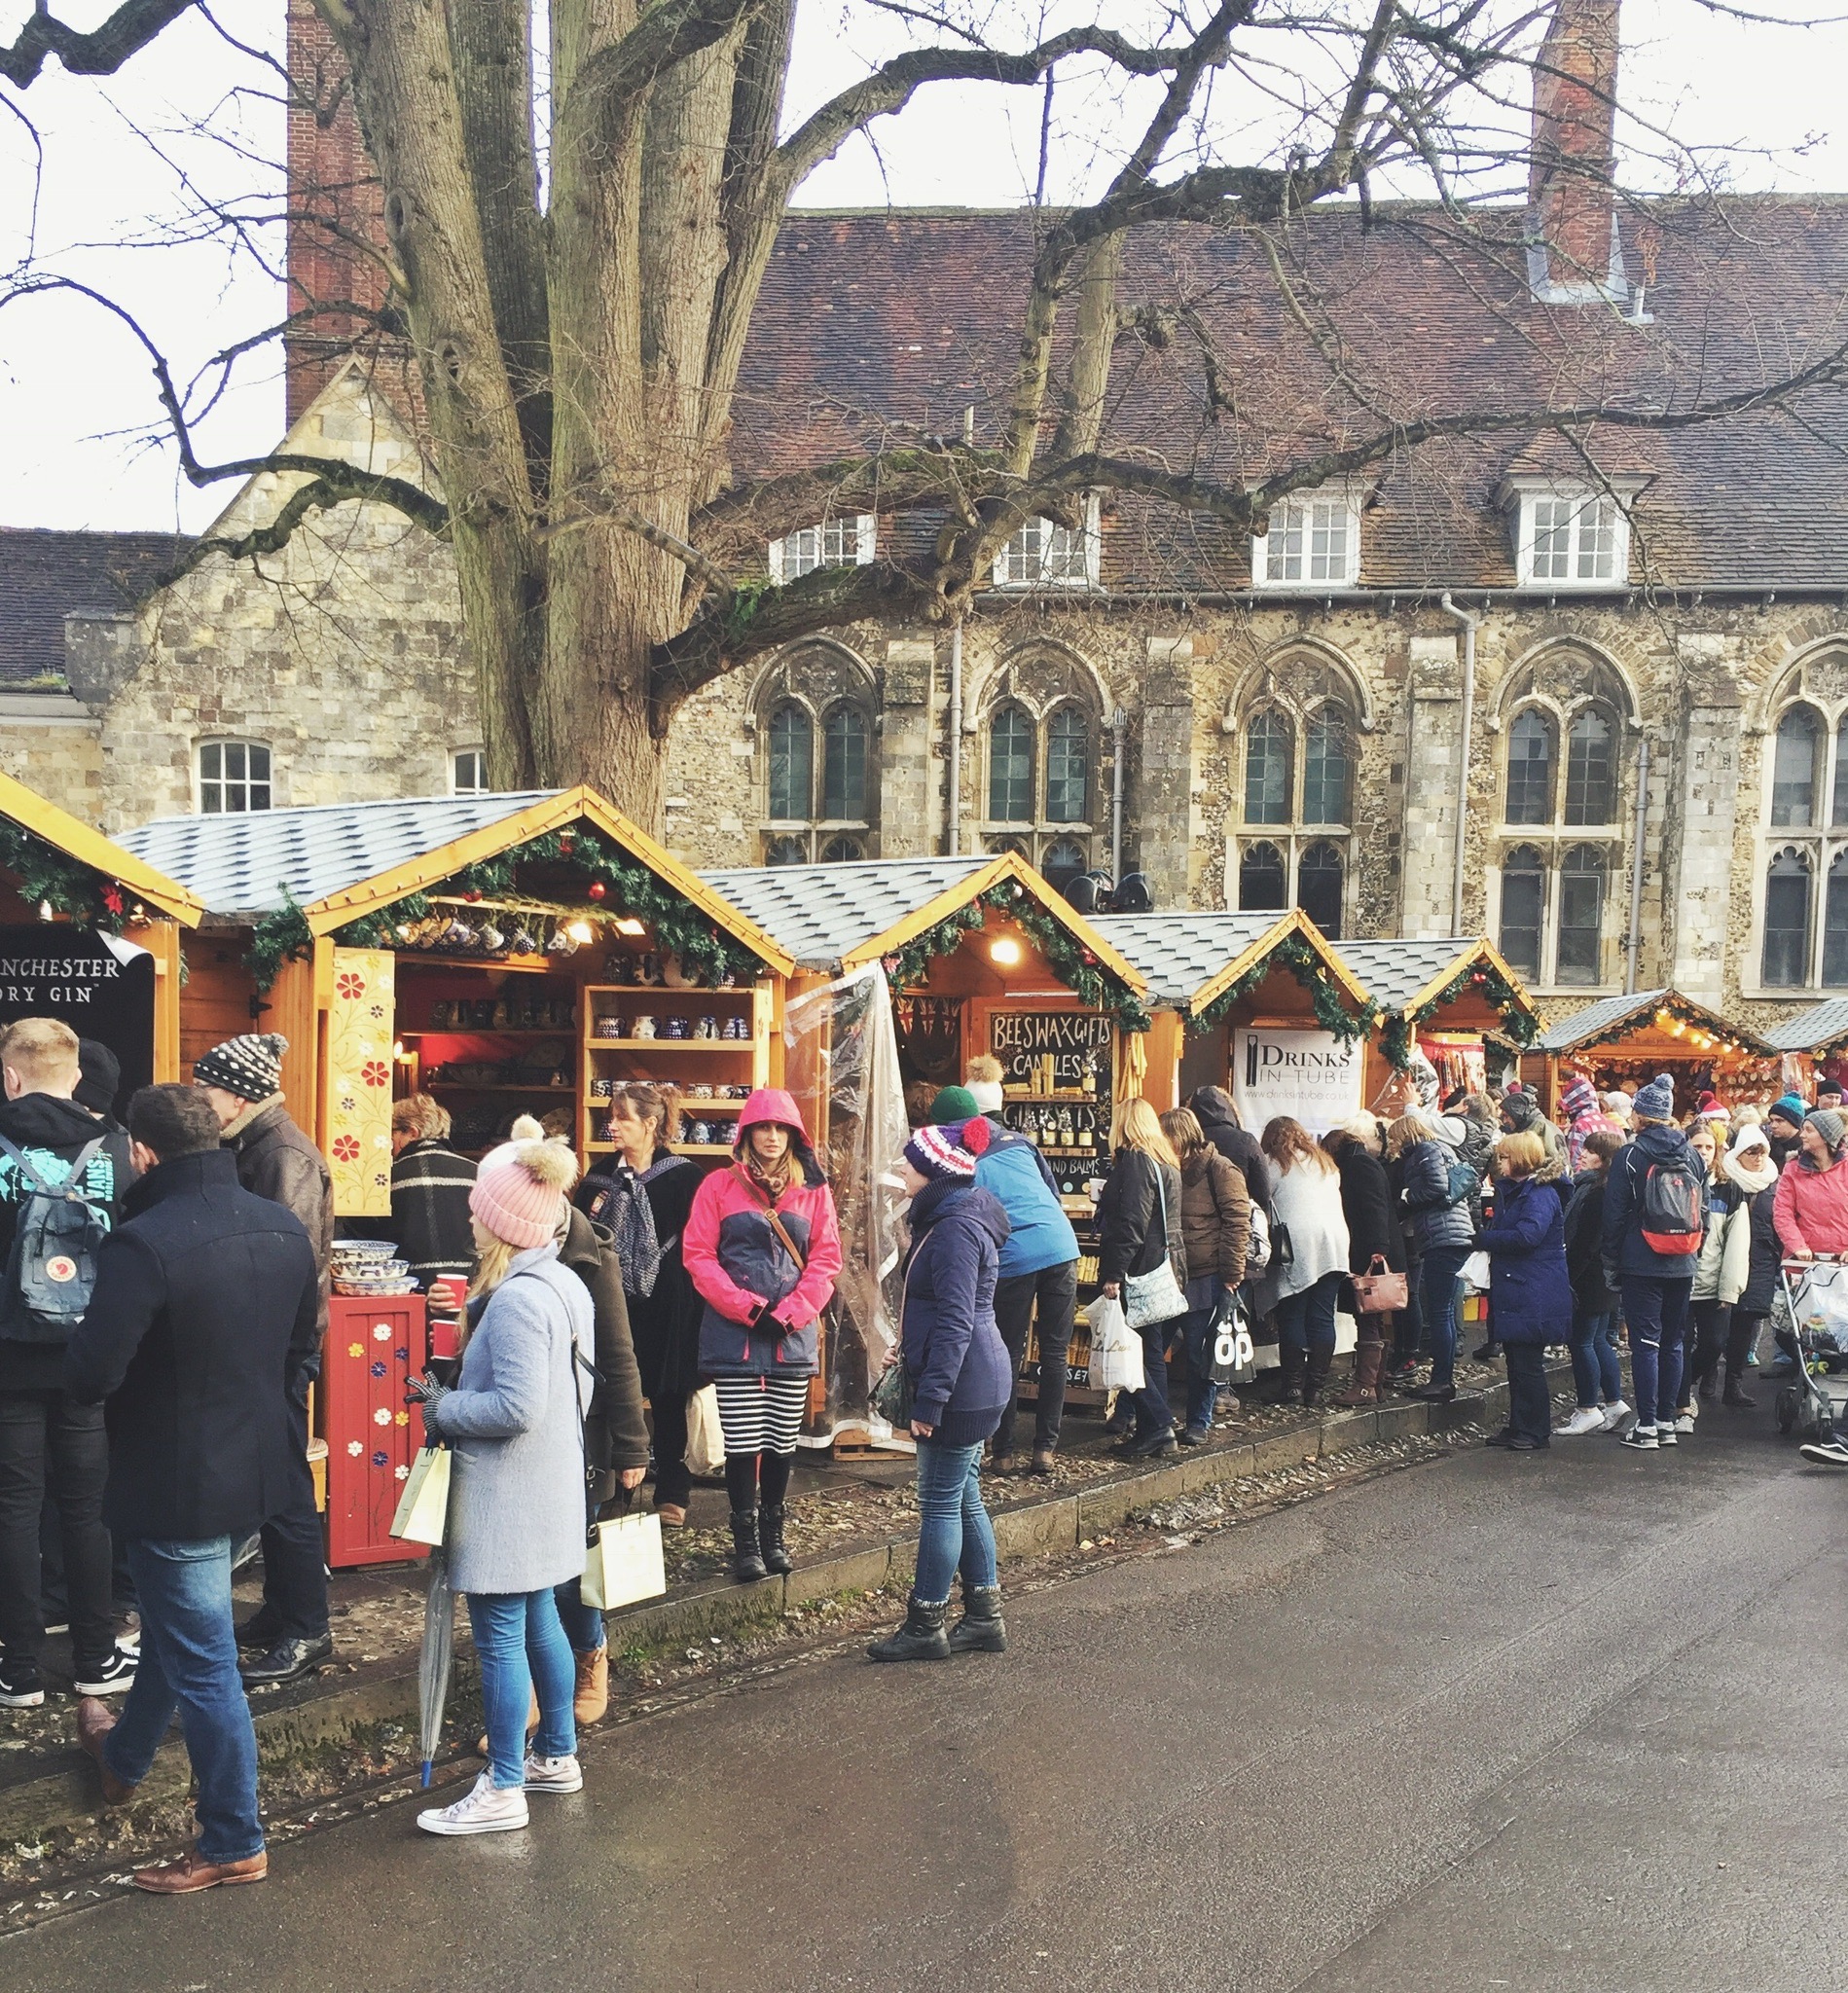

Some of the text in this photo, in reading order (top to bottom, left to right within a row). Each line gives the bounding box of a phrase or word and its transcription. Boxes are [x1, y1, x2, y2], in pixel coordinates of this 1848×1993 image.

[1074, 1017, 1110, 1046] GIFTS
[1013, 1054, 1082, 1079] CANLES
[1259, 1069, 1350, 1085] IN TUBE
[1244, 1089, 1350, 1102] www.drinksintube.co.uk
[86, 1159, 106, 1199] VANS
